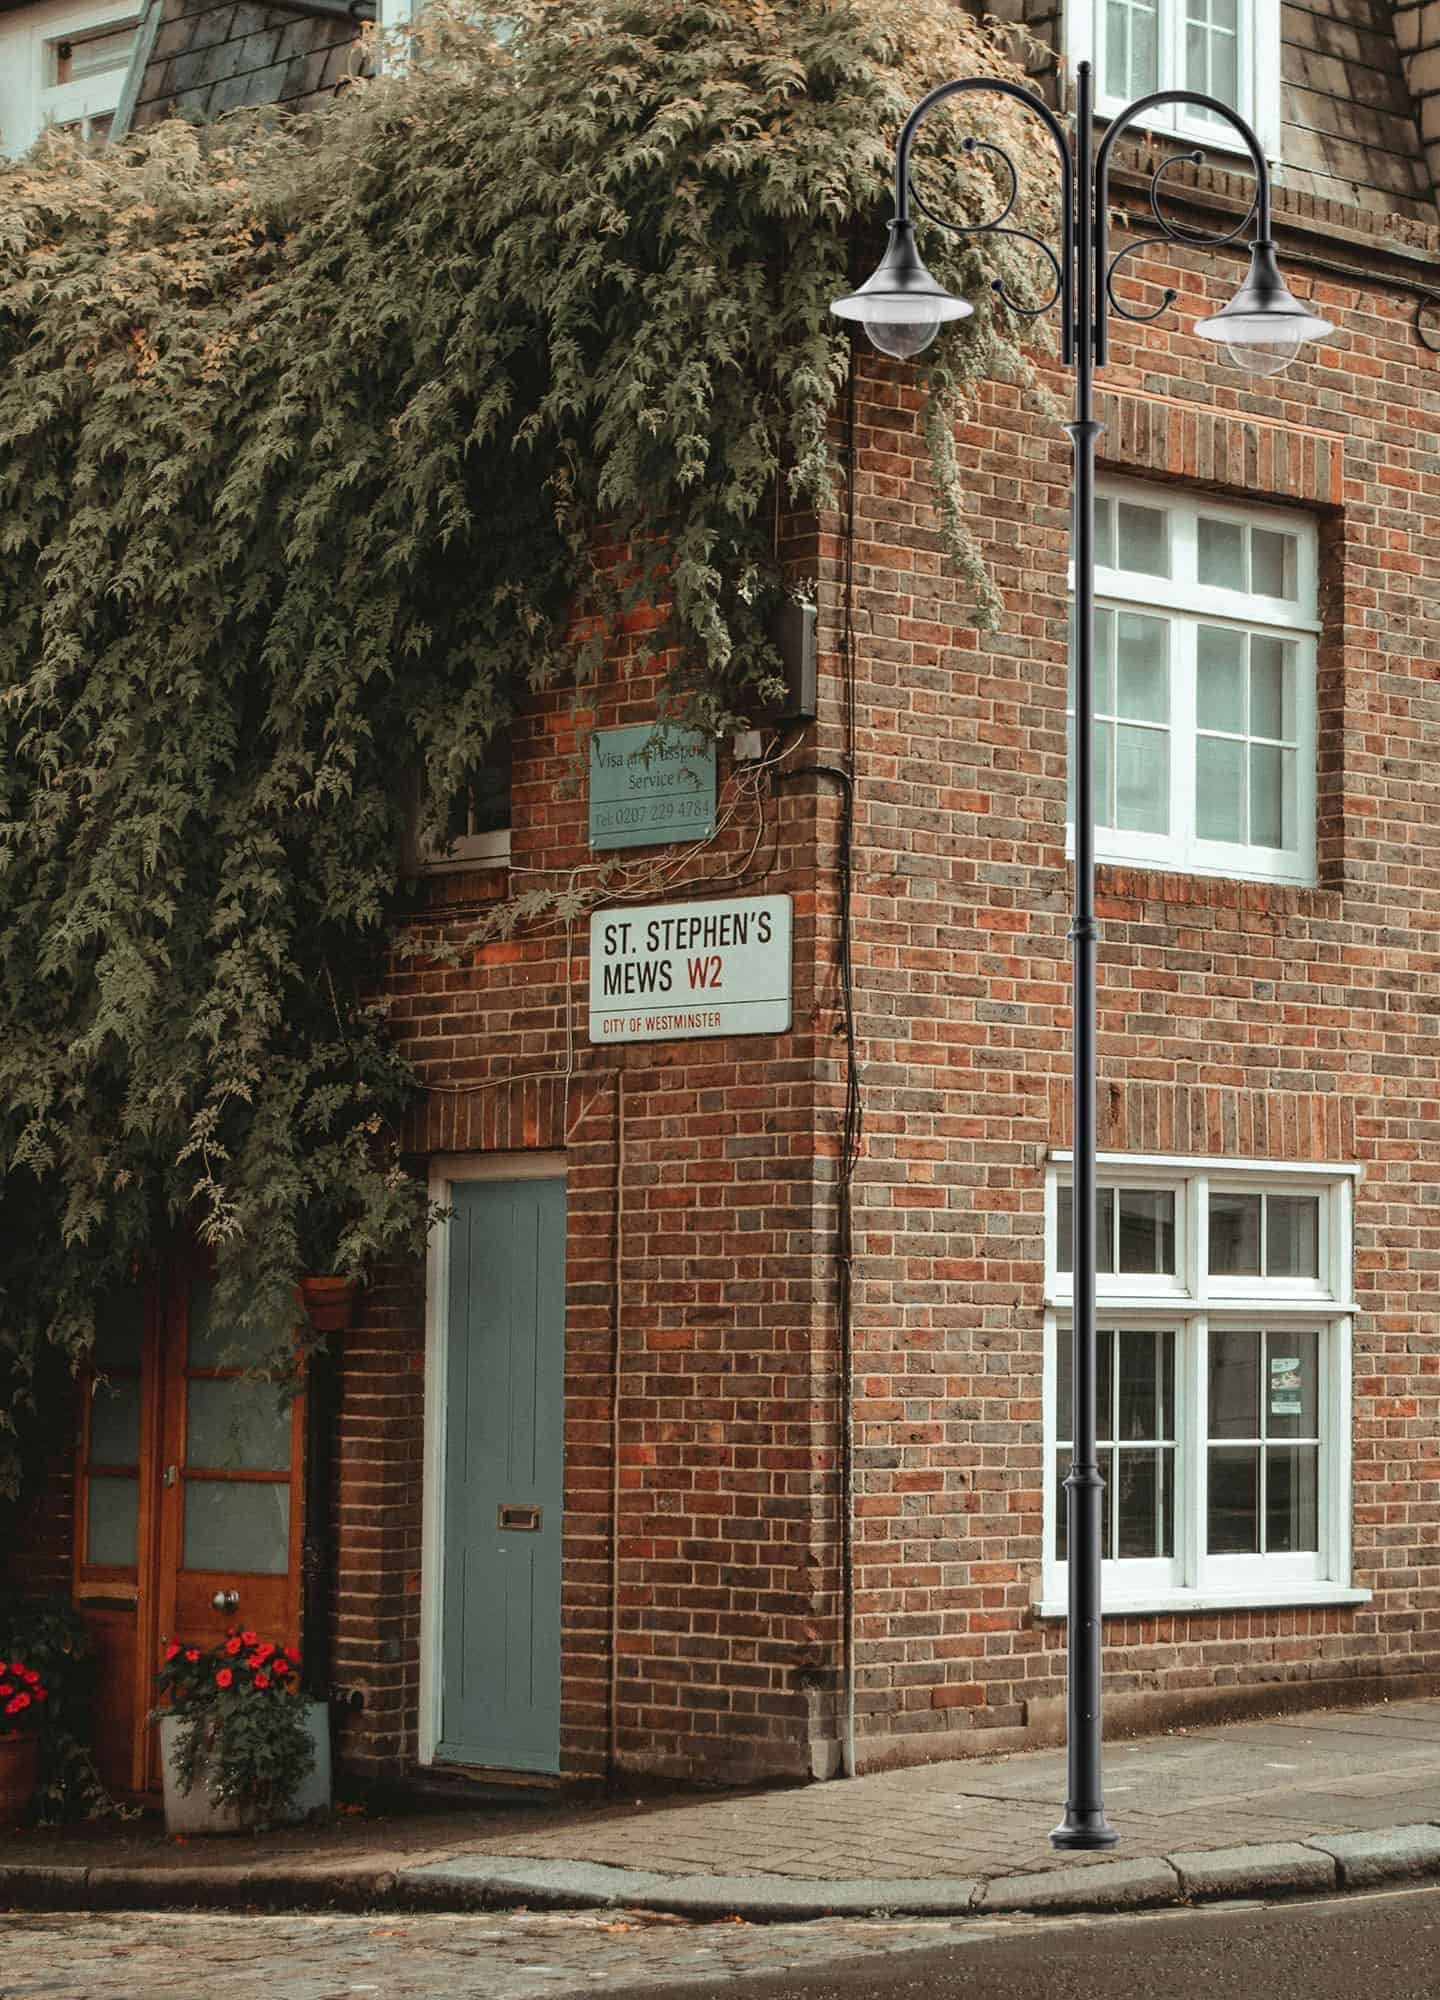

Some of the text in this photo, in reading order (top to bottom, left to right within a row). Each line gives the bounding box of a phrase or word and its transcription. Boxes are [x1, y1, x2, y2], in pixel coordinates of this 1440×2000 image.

[598, 751, 623, 768] Visa
[628, 770, 674, 790] Service
[616, 806, 647, 825] 0207
[651, 803, 674, 821] 229
[678, 799, 710, 817] 4784
[604, 910, 772, 956] ST. STEPHEN'S
[603, 955, 723, 996] MEWS W2
[603, 1012, 721, 1034] CITY OF WESTMINSTER
